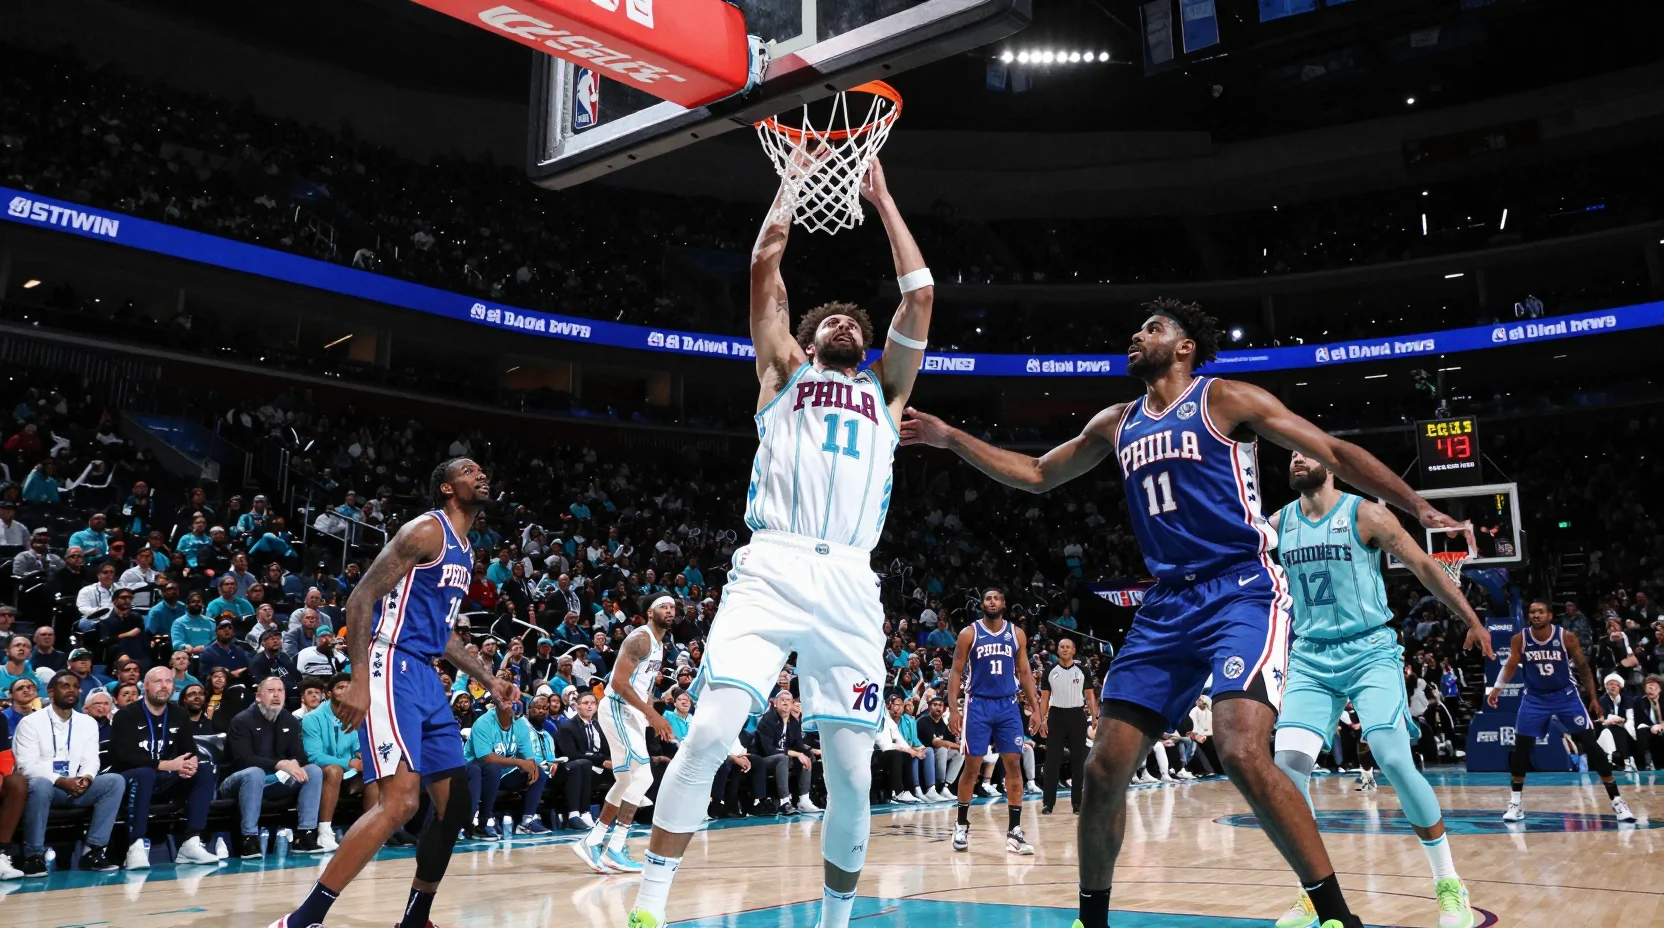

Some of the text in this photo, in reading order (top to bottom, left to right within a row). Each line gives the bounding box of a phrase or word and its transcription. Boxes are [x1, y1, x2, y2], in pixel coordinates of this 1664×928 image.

[793, 381, 879, 426] PHILA
[821, 413, 860, 460] 11
[1141, 470, 1177, 516] 11
[1298, 570, 1337, 607] 12
[990, 659, 1003, 675] 11
[852, 681, 879, 713] 76
